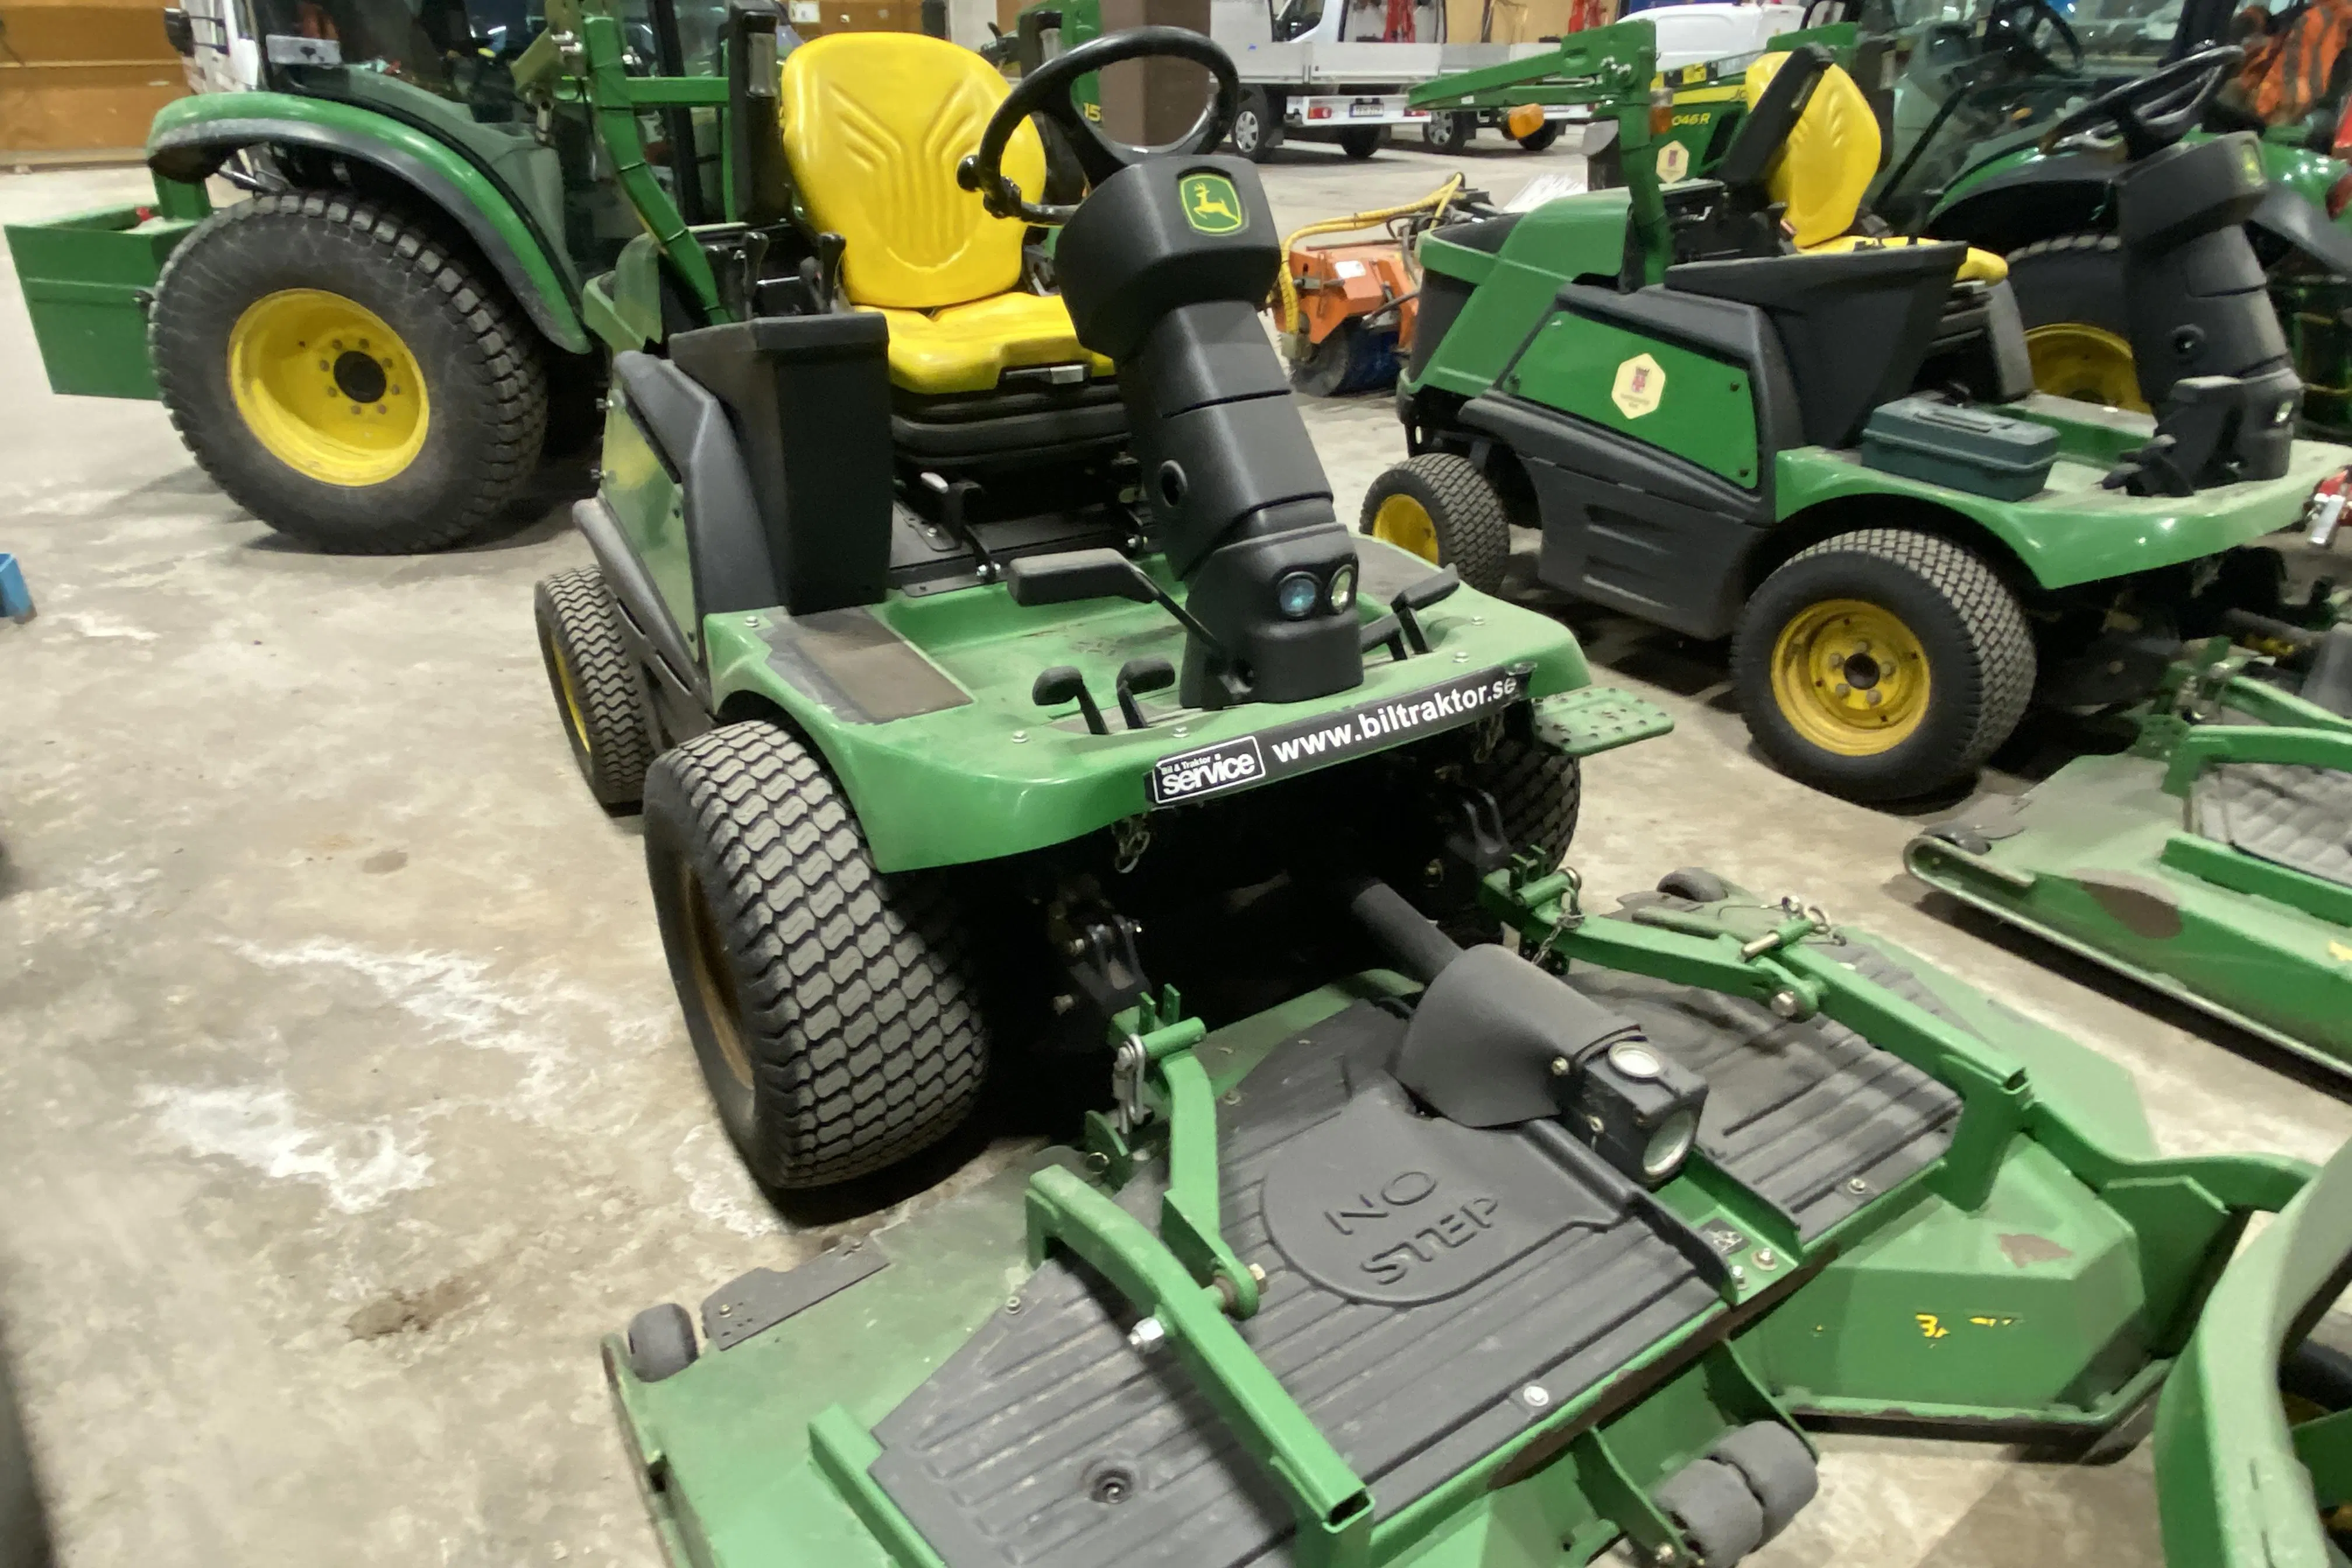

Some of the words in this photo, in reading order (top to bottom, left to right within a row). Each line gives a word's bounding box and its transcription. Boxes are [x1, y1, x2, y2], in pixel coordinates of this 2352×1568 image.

[1671, 113, 1711, 126] 046R
[1272, 676, 1517, 763] www.biltraktor.se
[1162, 753, 1255, 795] service
[1181, 757, 1211, 769] Traktor
[1324, 1171, 1437, 1236] NO
[1359, 1198, 1499, 1286] STEP
